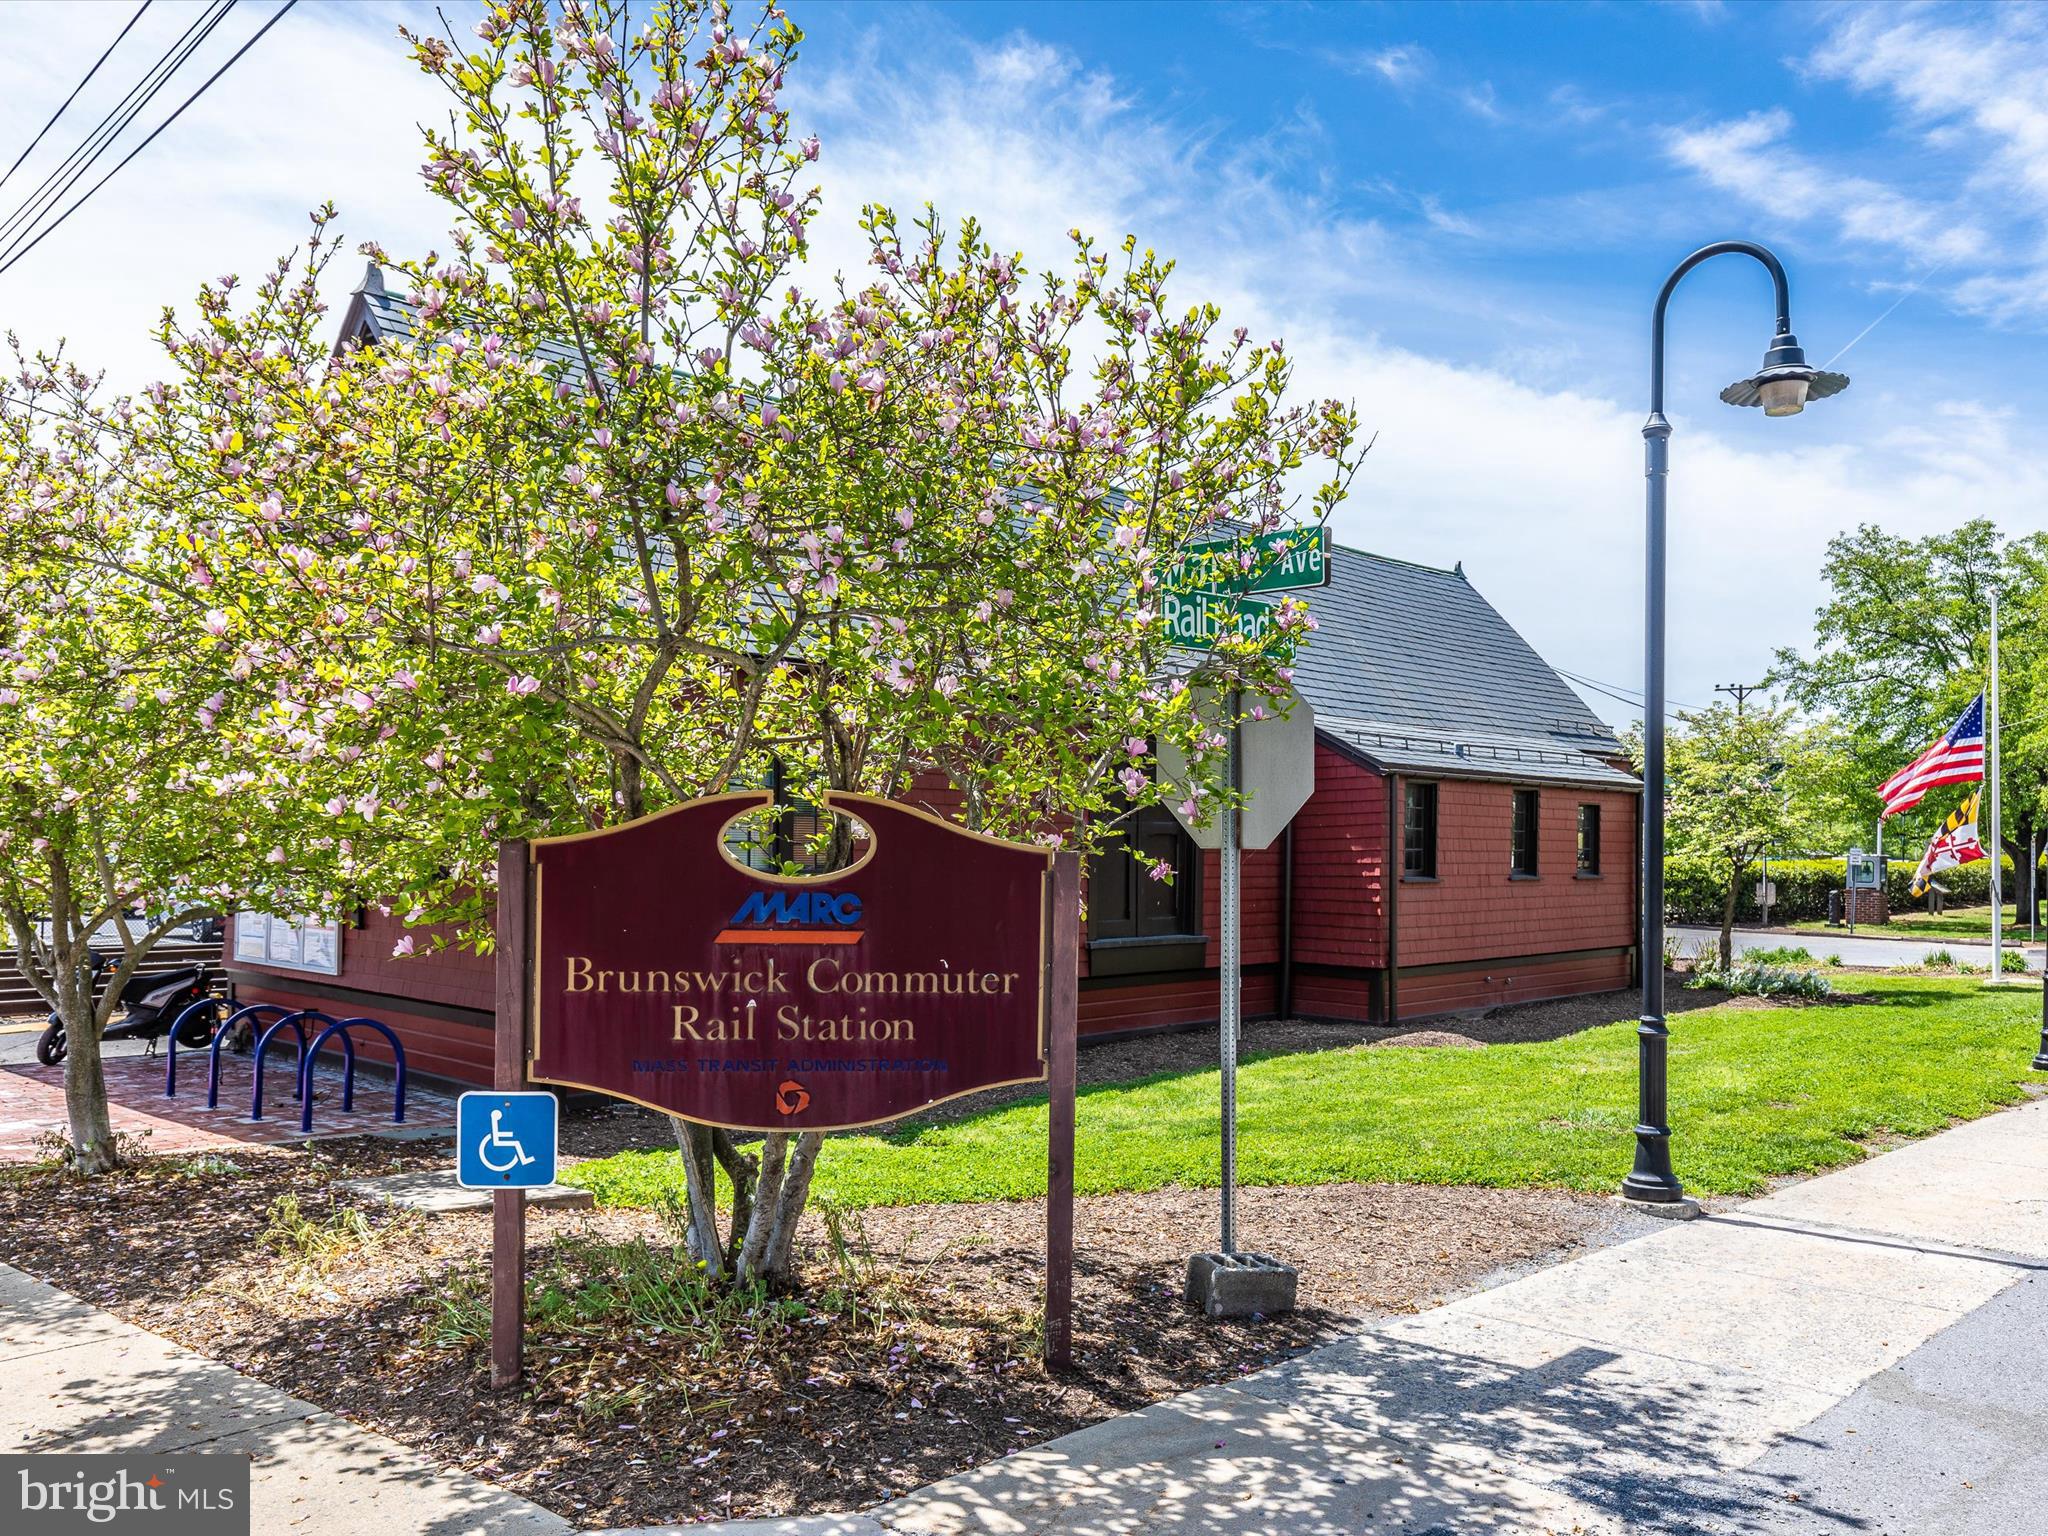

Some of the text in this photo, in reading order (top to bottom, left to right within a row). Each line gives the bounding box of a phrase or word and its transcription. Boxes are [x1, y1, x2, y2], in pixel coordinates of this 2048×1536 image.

[1281, 548, 1321, 575] Ave
[730, 891, 863, 925] MARC
[564, 956, 1019, 994] Brunswick Commuter
[672, 1003, 917, 1041] Rail Station
[632, 1058, 949, 1073] MASS TRANSIT ADMINISTRATION
